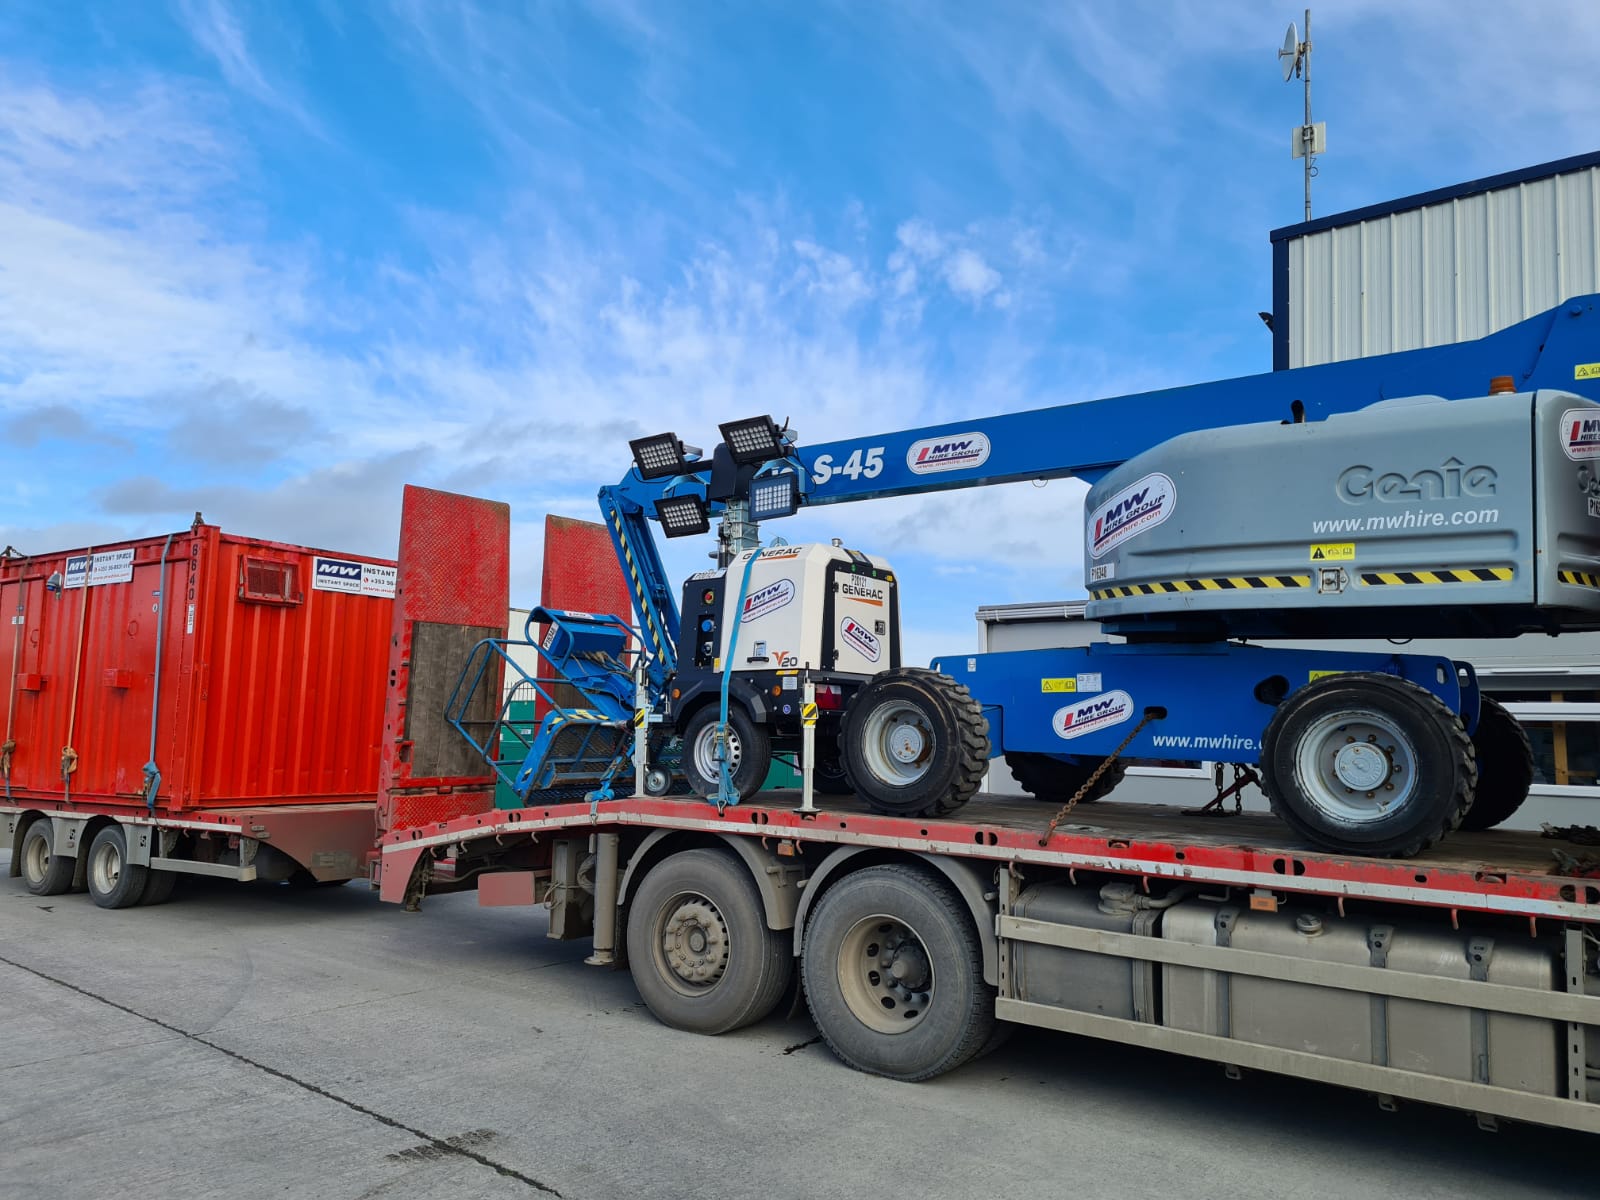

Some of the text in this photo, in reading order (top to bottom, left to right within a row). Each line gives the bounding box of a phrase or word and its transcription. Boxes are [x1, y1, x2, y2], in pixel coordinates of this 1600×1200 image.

[1582, 419, 1600, 433] M
[928, 448, 983, 460] HIRE GROUP
[932, 440, 974, 454] MW
[813, 447, 885, 485] S-45
[1335, 456, 1498, 506] Genie
[1103, 494, 1166, 534] HIRE GROUP
[1105, 486, 1150, 525] MW
[1312, 508, 1499, 534] www.mwhire.com
[1095, 510, 1161, 551] www.mwhire.com
[742, 547, 802, 560] GNERAC
[318, 563, 360, 576] MW
[363, 567, 396, 577] INSTANT
[753, 584, 781, 602] MW
[842, 583, 883, 600] GENERAC
[854, 626, 875, 643] MW
[772, 651, 798, 667] V20
[1075, 703, 1126, 724] HIRE GROUP
[1077, 698, 1114, 718] MW
